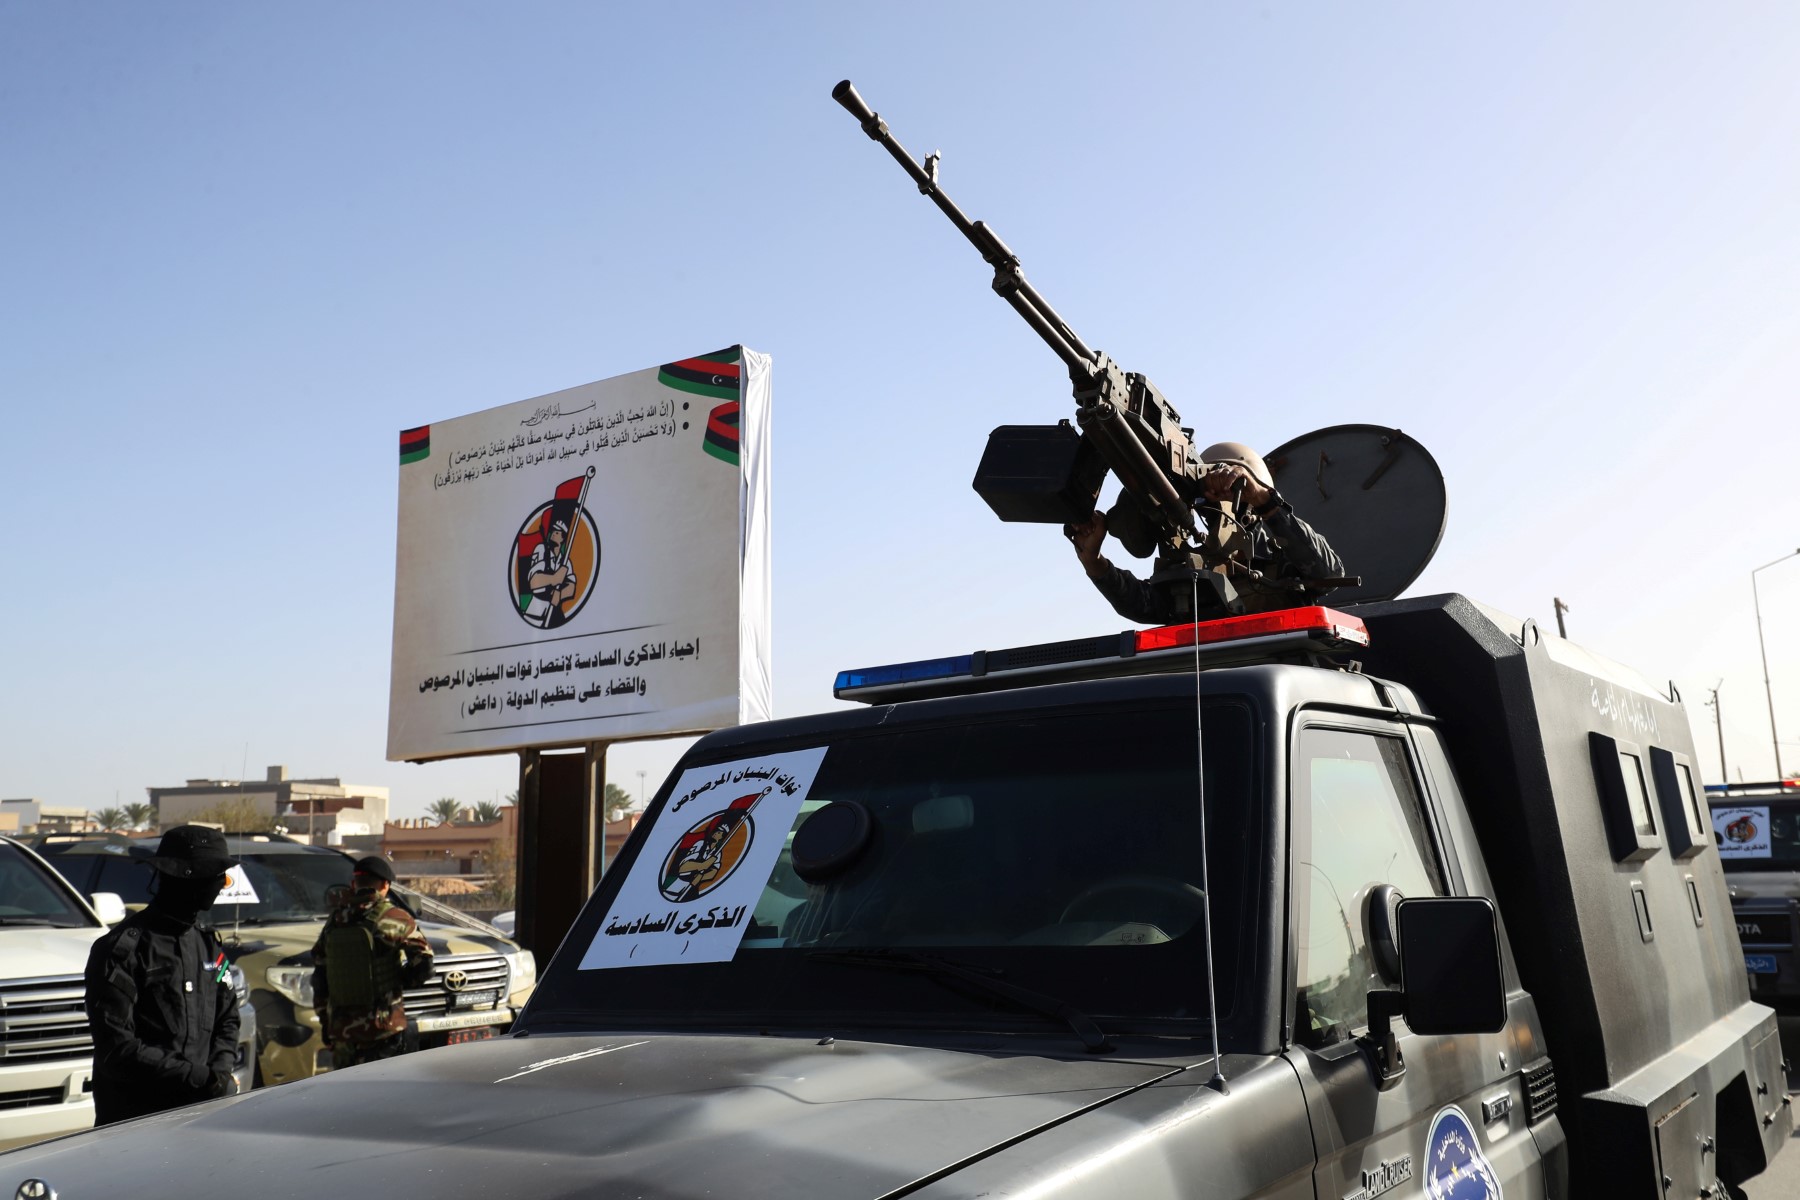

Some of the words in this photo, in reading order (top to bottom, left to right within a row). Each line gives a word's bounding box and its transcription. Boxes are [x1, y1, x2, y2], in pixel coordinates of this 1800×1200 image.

[574, 648, 621, 670] السادسة
[623, 642, 666, 667] الذكرى
[668, 637, 700, 661] إحياء
[466, 663, 504, 688] البنيان
[505, 660, 532, 681] قوات
[533, 654, 573, 679] لإنتصار
[418, 669, 465, 693] المرصوص
[578, 681, 602, 703] على
[605, 675, 647, 697] والقضاء
[468, 694, 497, 716] داعش
[506, 688, 538, 710] الدولة
[540, 685, 576, 709] تنظيم
[732, 766, 780, 784] البنيان
[671, 770, 733, 813] المرصوص
[604, 909, 679, 937] السادسة
[673, 904, 748, 936] الذكرى
